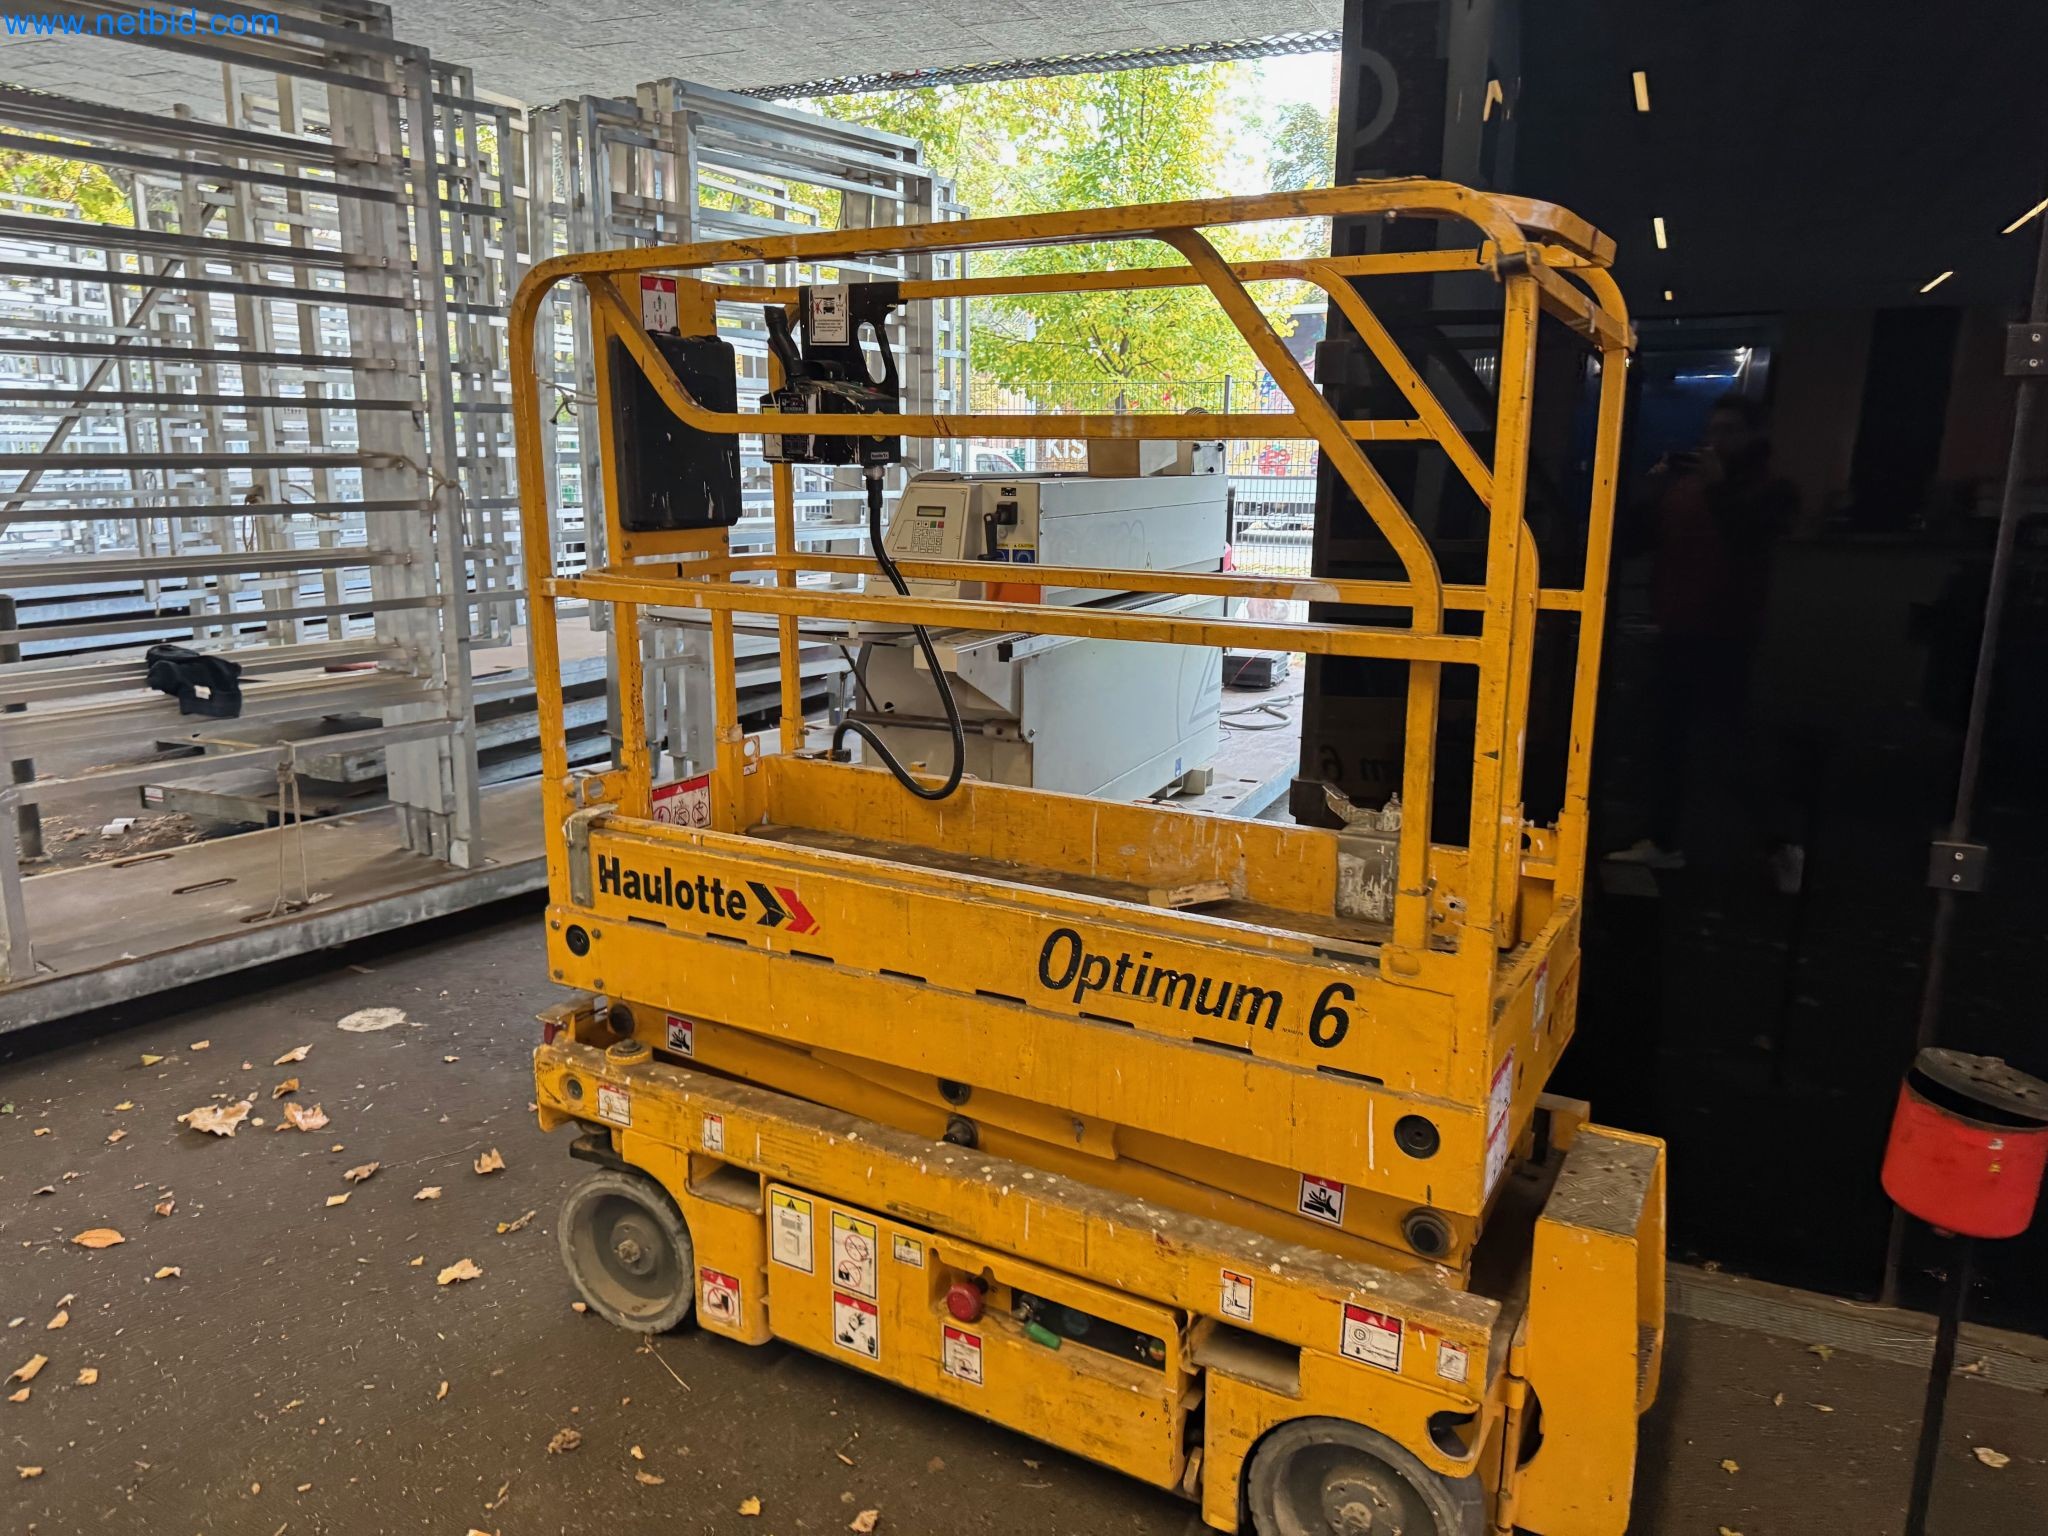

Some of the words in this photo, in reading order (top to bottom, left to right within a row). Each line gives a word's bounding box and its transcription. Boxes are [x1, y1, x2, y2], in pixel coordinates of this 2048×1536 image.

[598, 854, 747, 921] Haulotte
[1038, 927, 1283, 1031] Optimum
[1308, 982, 1356, 1049] 6
